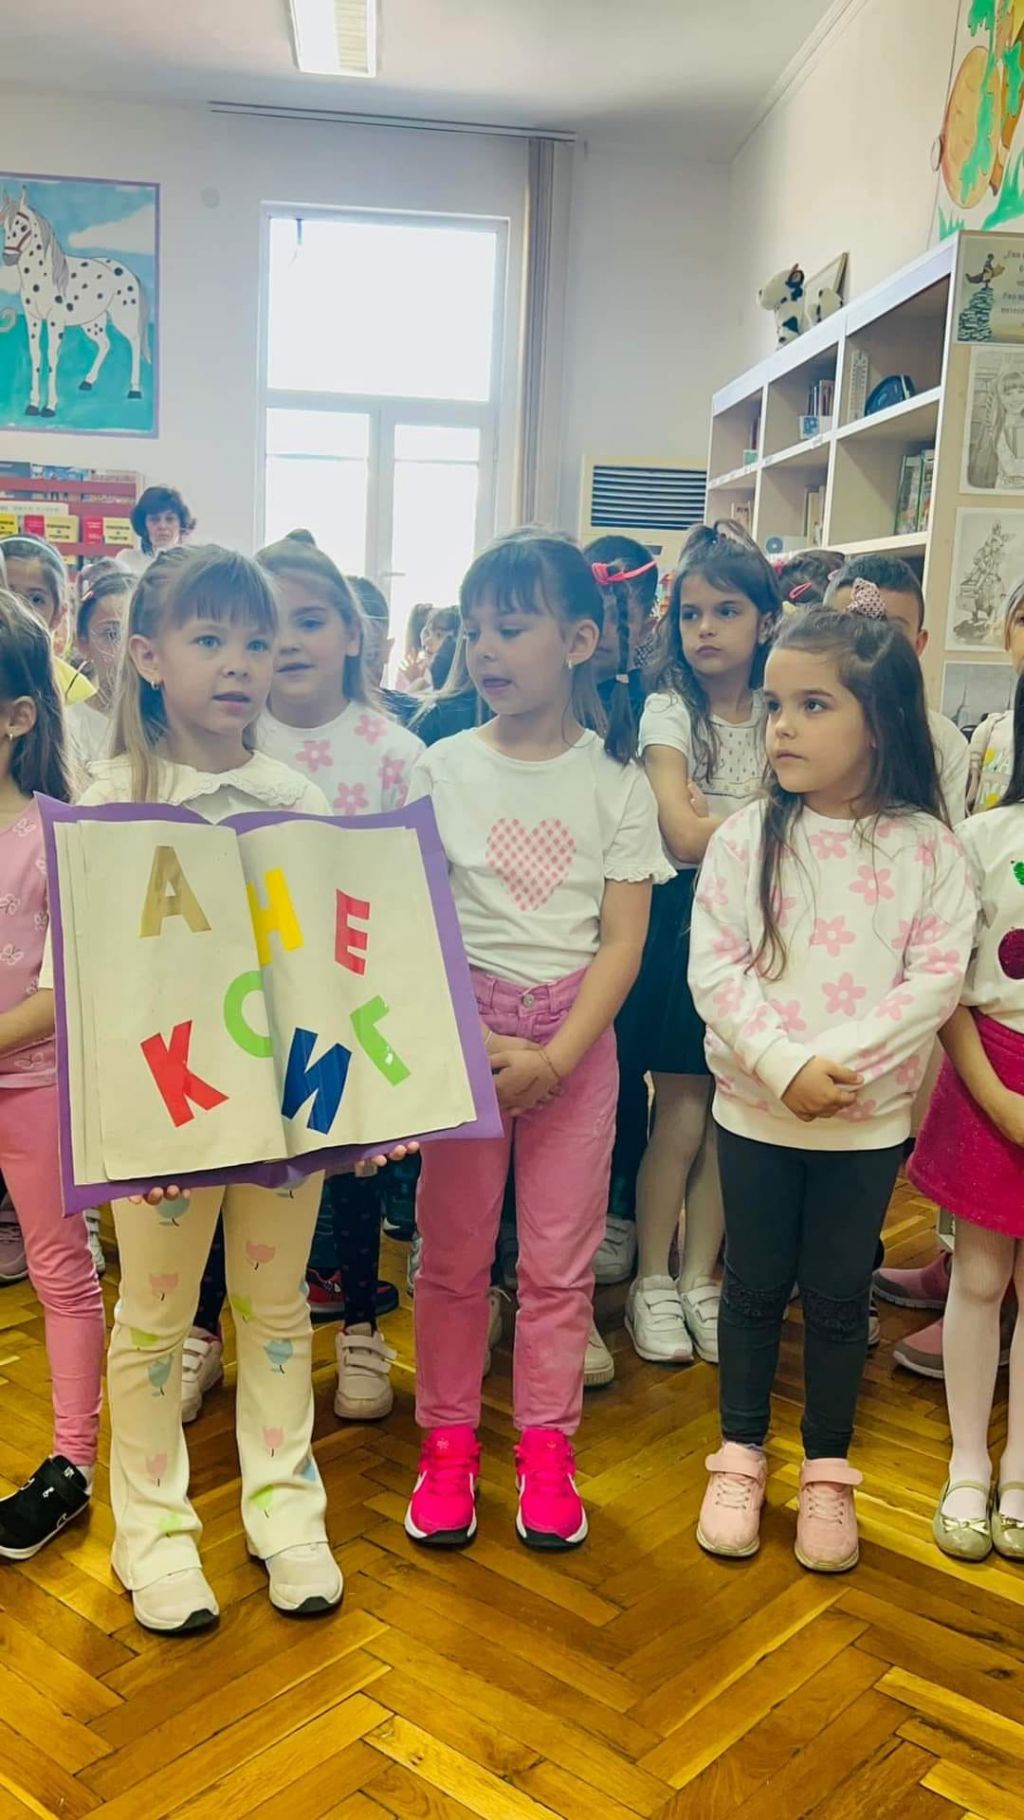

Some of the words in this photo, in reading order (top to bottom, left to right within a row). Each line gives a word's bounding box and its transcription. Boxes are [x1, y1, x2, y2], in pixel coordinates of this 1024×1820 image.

[138, 845, 212, 938] А
[334, 888, 371, 976] Е
[140, 1020, 229, 1128] К
[281, 1027, 352, 1135] И
